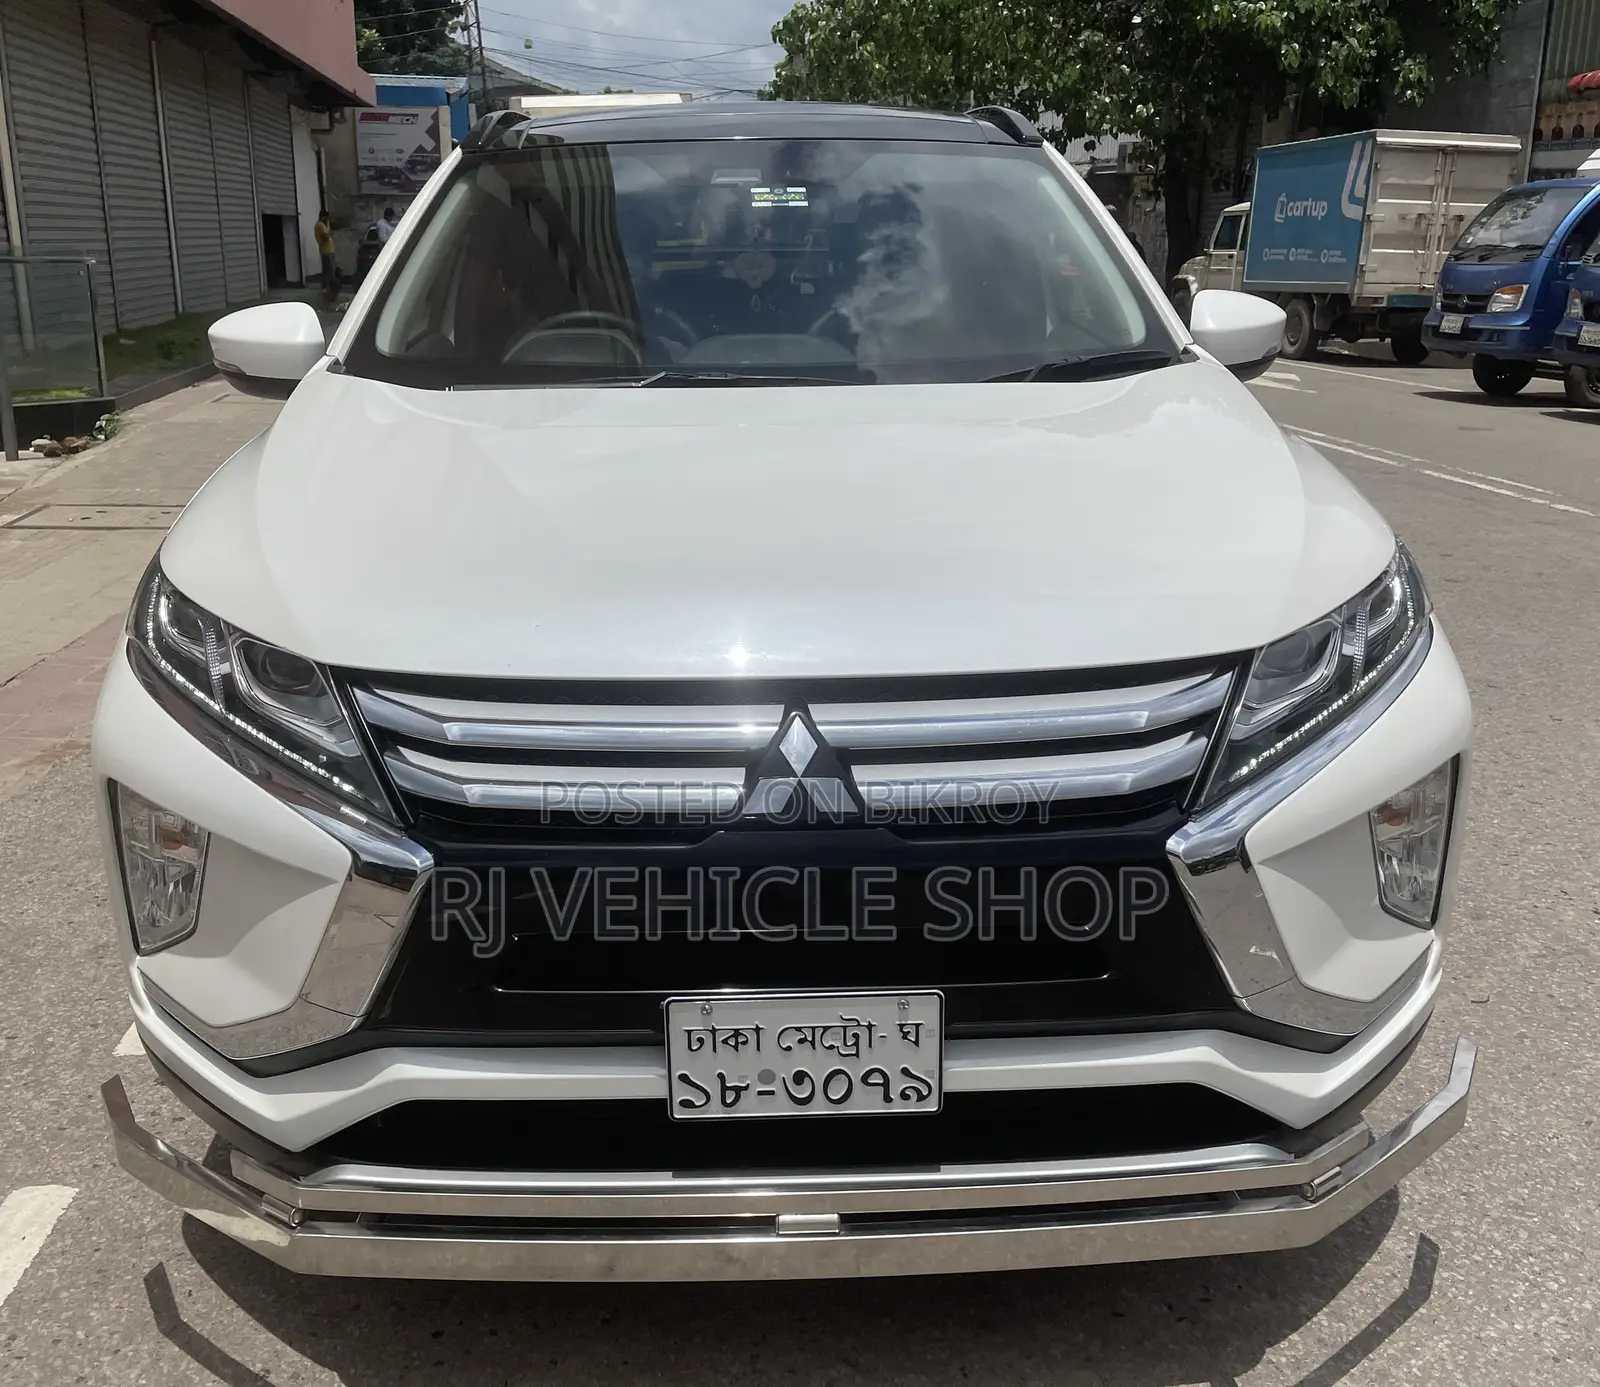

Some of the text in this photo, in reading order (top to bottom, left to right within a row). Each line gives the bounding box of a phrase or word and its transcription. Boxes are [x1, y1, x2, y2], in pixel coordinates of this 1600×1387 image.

[1287, 198, 1328, 221] cartup
[683, 1023, 765, 1053] ঢাকা
[896, 1021, 924, 1048] ঘ
[677, 1065, 933, 1109] ১৮-৩০৭৯
